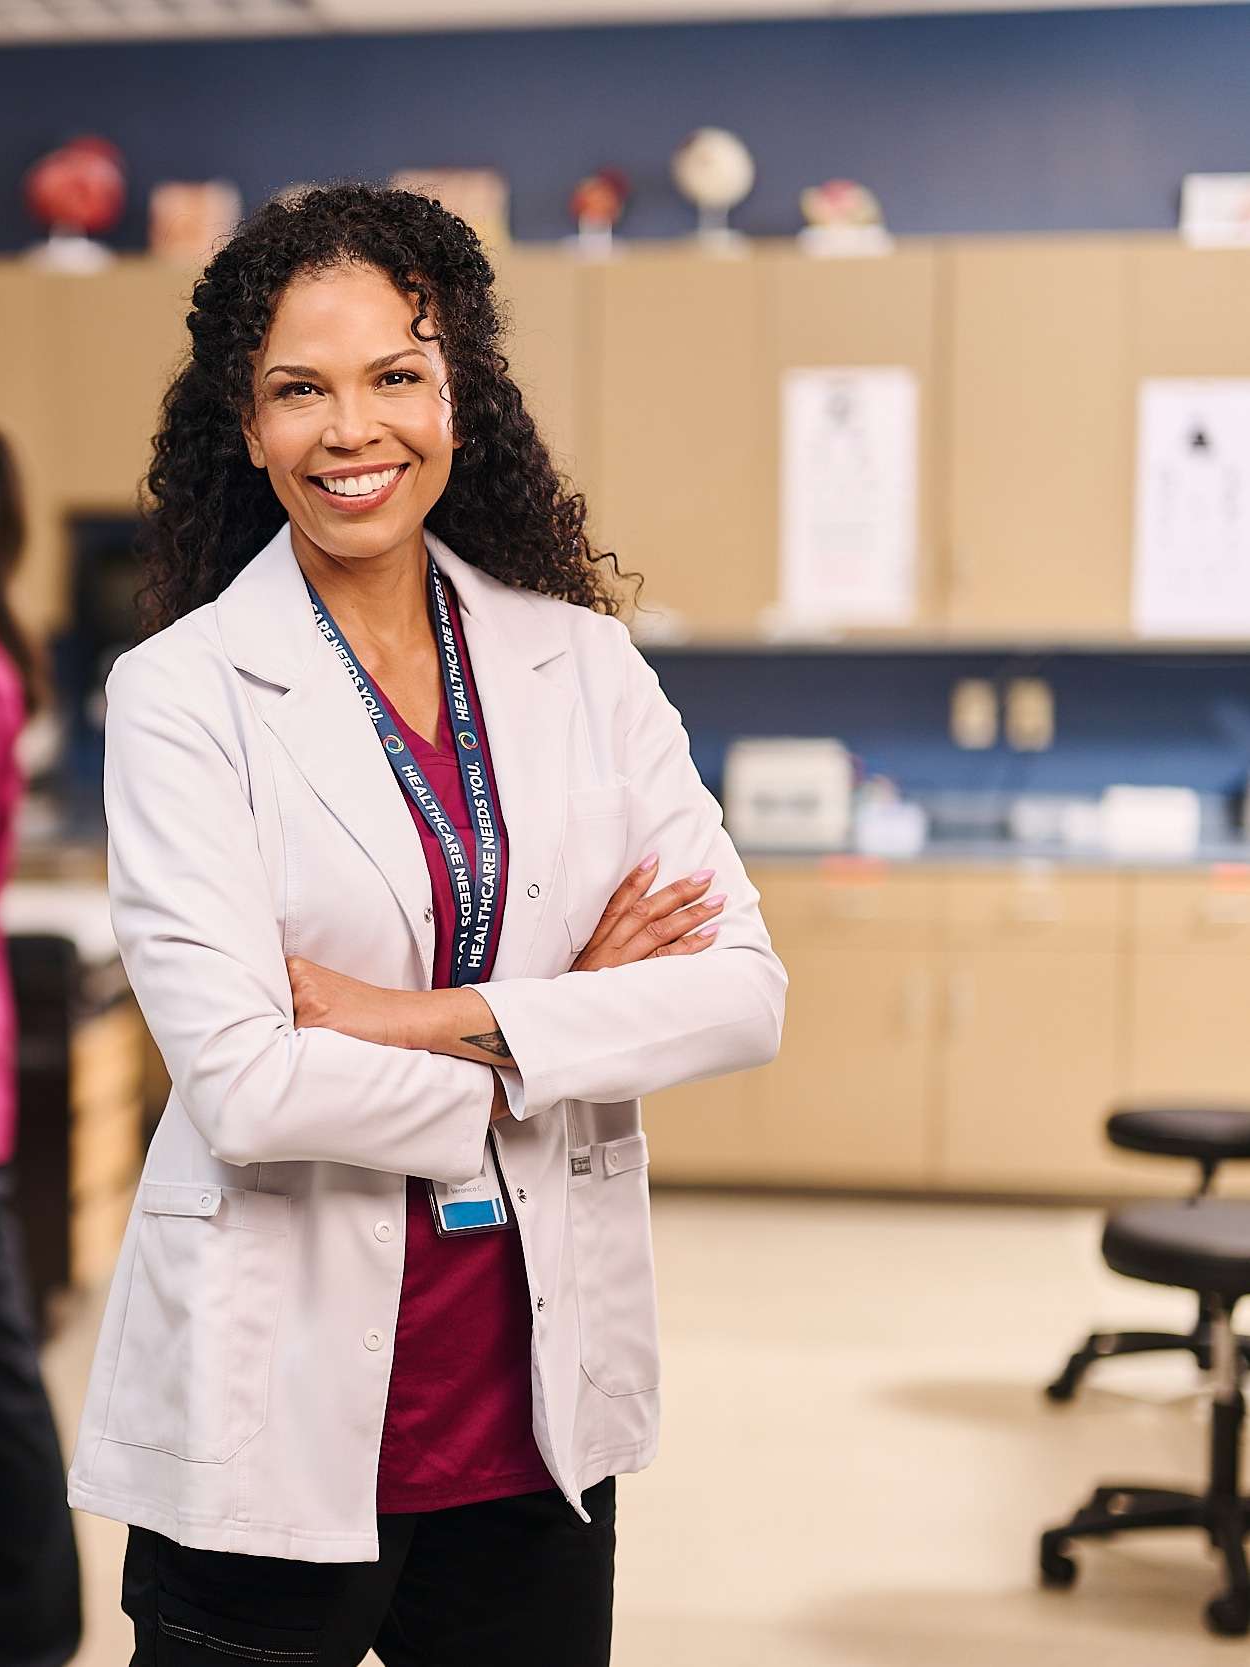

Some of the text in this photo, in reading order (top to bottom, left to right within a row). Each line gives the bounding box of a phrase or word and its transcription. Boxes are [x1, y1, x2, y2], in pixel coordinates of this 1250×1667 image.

[433, 576, 451, 626] NEEDS
[330, 638, 364, 687] NEEDS
[359, 686, 384, 725] YOU.
[440, 625, 471, 722] HEALTHCARE
[401, 765, 464, 866] HEALTHCARE
[455, 867, 472, 927] NEEDS
[466, 761, 496, 968] HEALTHCARE NEEDS YOU.
